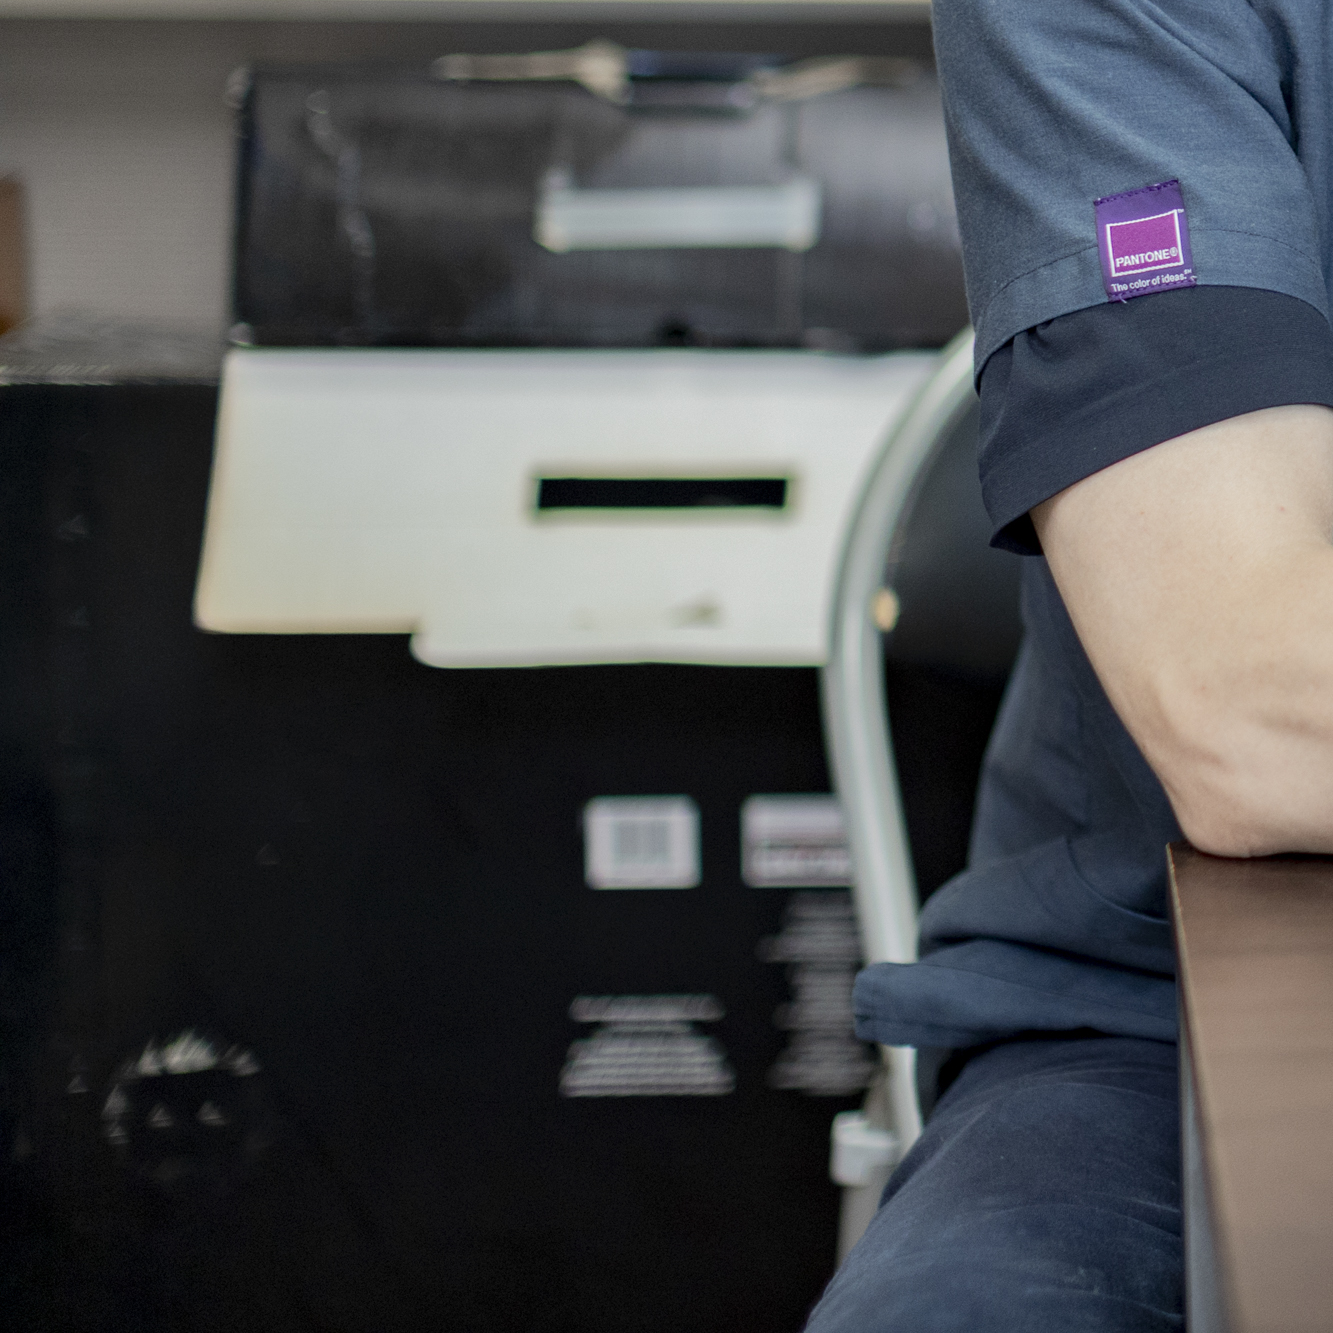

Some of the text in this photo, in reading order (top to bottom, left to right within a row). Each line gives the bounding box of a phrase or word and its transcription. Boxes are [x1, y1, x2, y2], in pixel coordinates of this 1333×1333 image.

[1111, 283, 1129, 292] The
[1129, 279, 1151, 290] color
[1151, 275, 1161, 286] of
